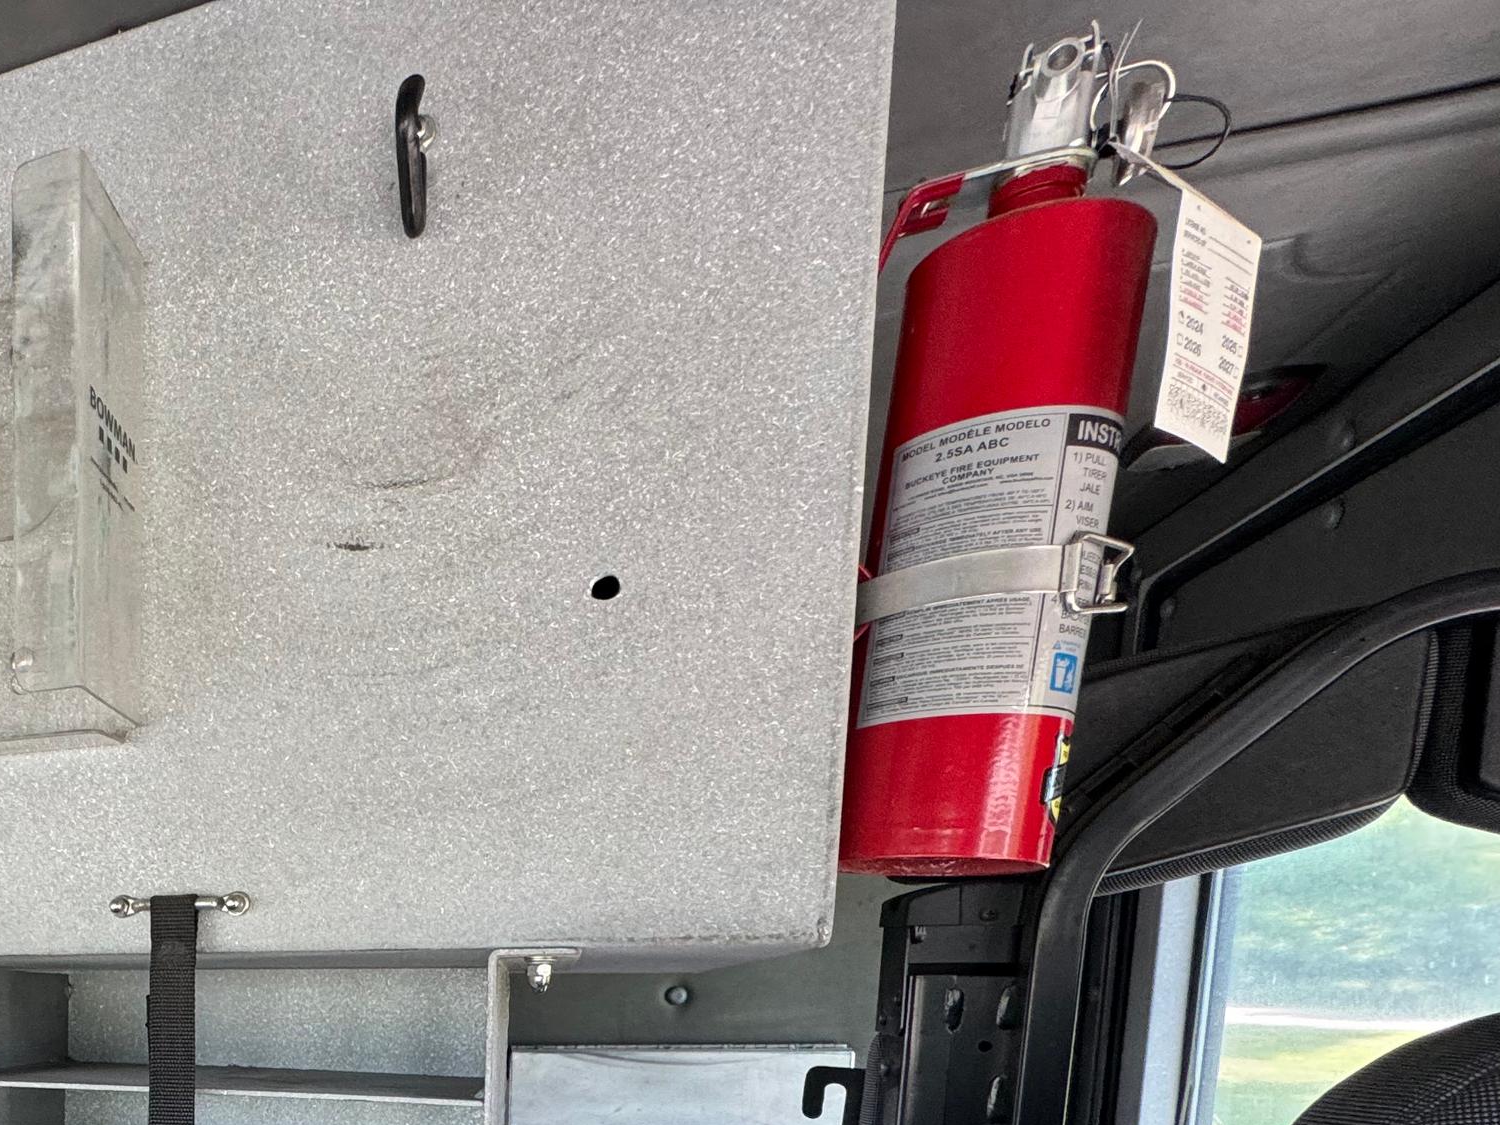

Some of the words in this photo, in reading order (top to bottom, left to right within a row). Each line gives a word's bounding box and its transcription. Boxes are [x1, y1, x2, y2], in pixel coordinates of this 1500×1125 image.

[89, 384, 136, 463] BOWMAN
[902, 443, 936, 462] MODEL
[939, 426, 992, 446] MODÈLE
[994, 418, 1051, 433] MODELO
[935, 445, 973, 462] 2.5SA
[977, 437, 1009, 451] ABC
[1085, 453, 1106, 466] PULL
[904, 470, 947, 490] BUCKEYE
[950, 462, 974, 475] FIRE
[977, 453, 1040, 469] EQUIPMENT
[942, 467, 994, 485] COMPANY
[1080, 482, 1100, 495] JALE
[1077, 501, 1094, 513] AIM
[1076, 515, 1099, 528] VISER
